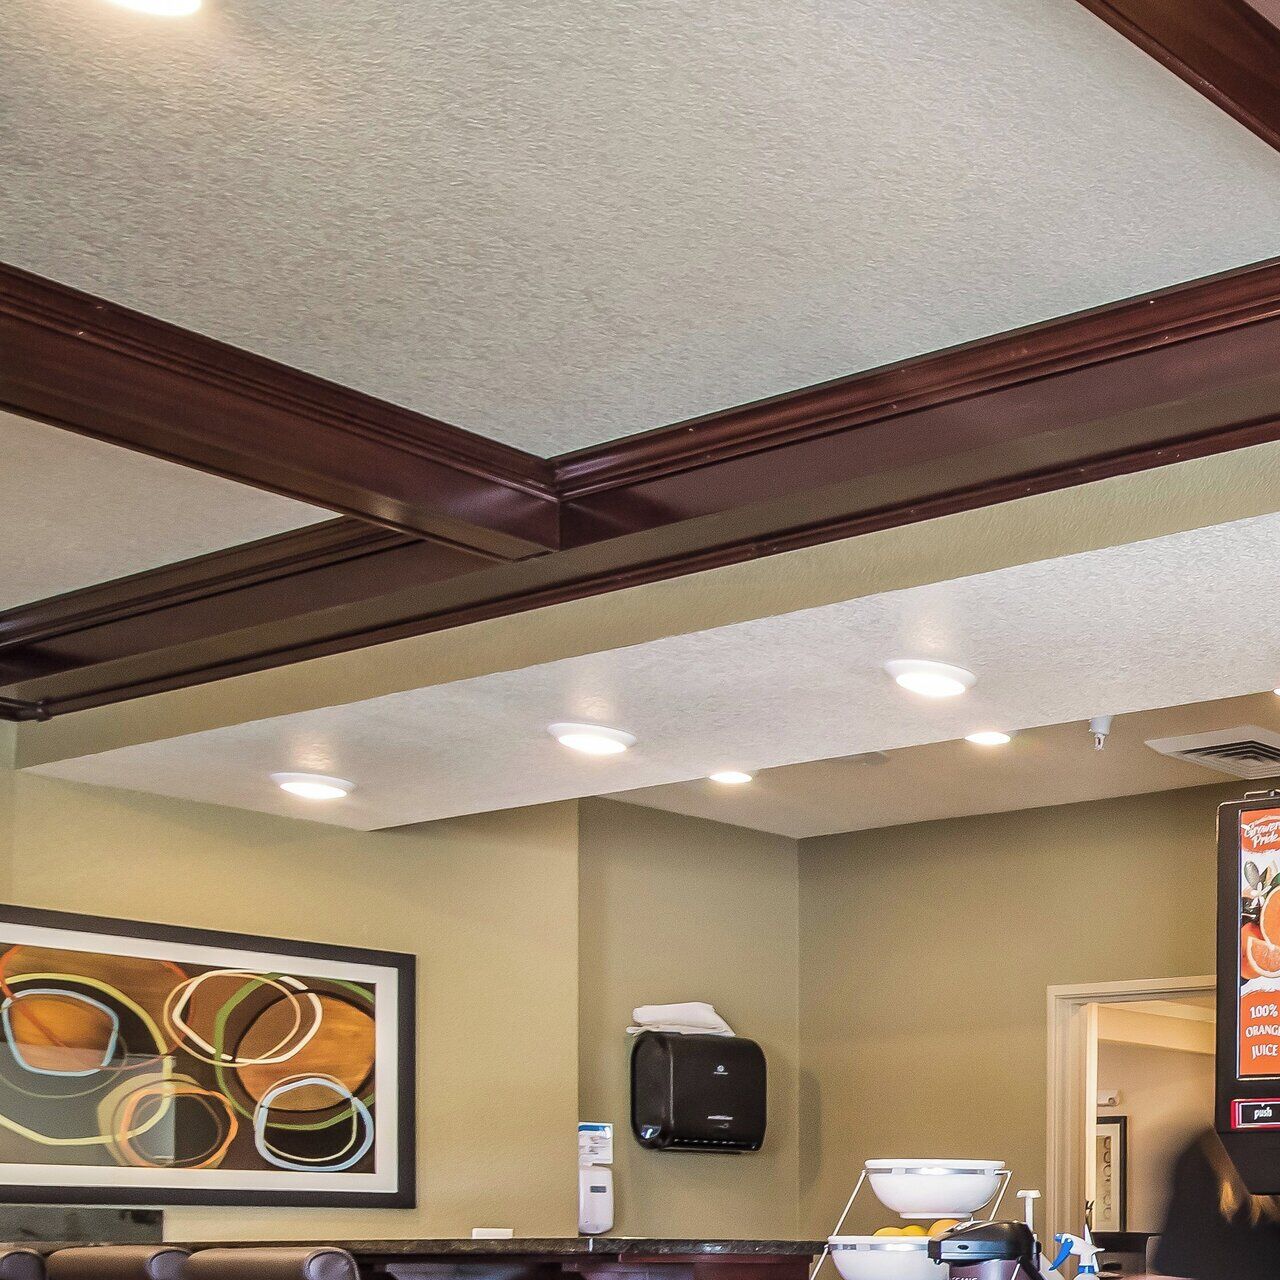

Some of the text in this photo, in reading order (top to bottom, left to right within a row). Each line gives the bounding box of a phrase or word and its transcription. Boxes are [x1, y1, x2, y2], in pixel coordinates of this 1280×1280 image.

[1251, 832, 1280, 849] Pride
[1250, 1003, 1279, 1019] 100%
[1251, 1043, 1279, 1060] JUICE
[1253, 1106, 1273, 1120] push
